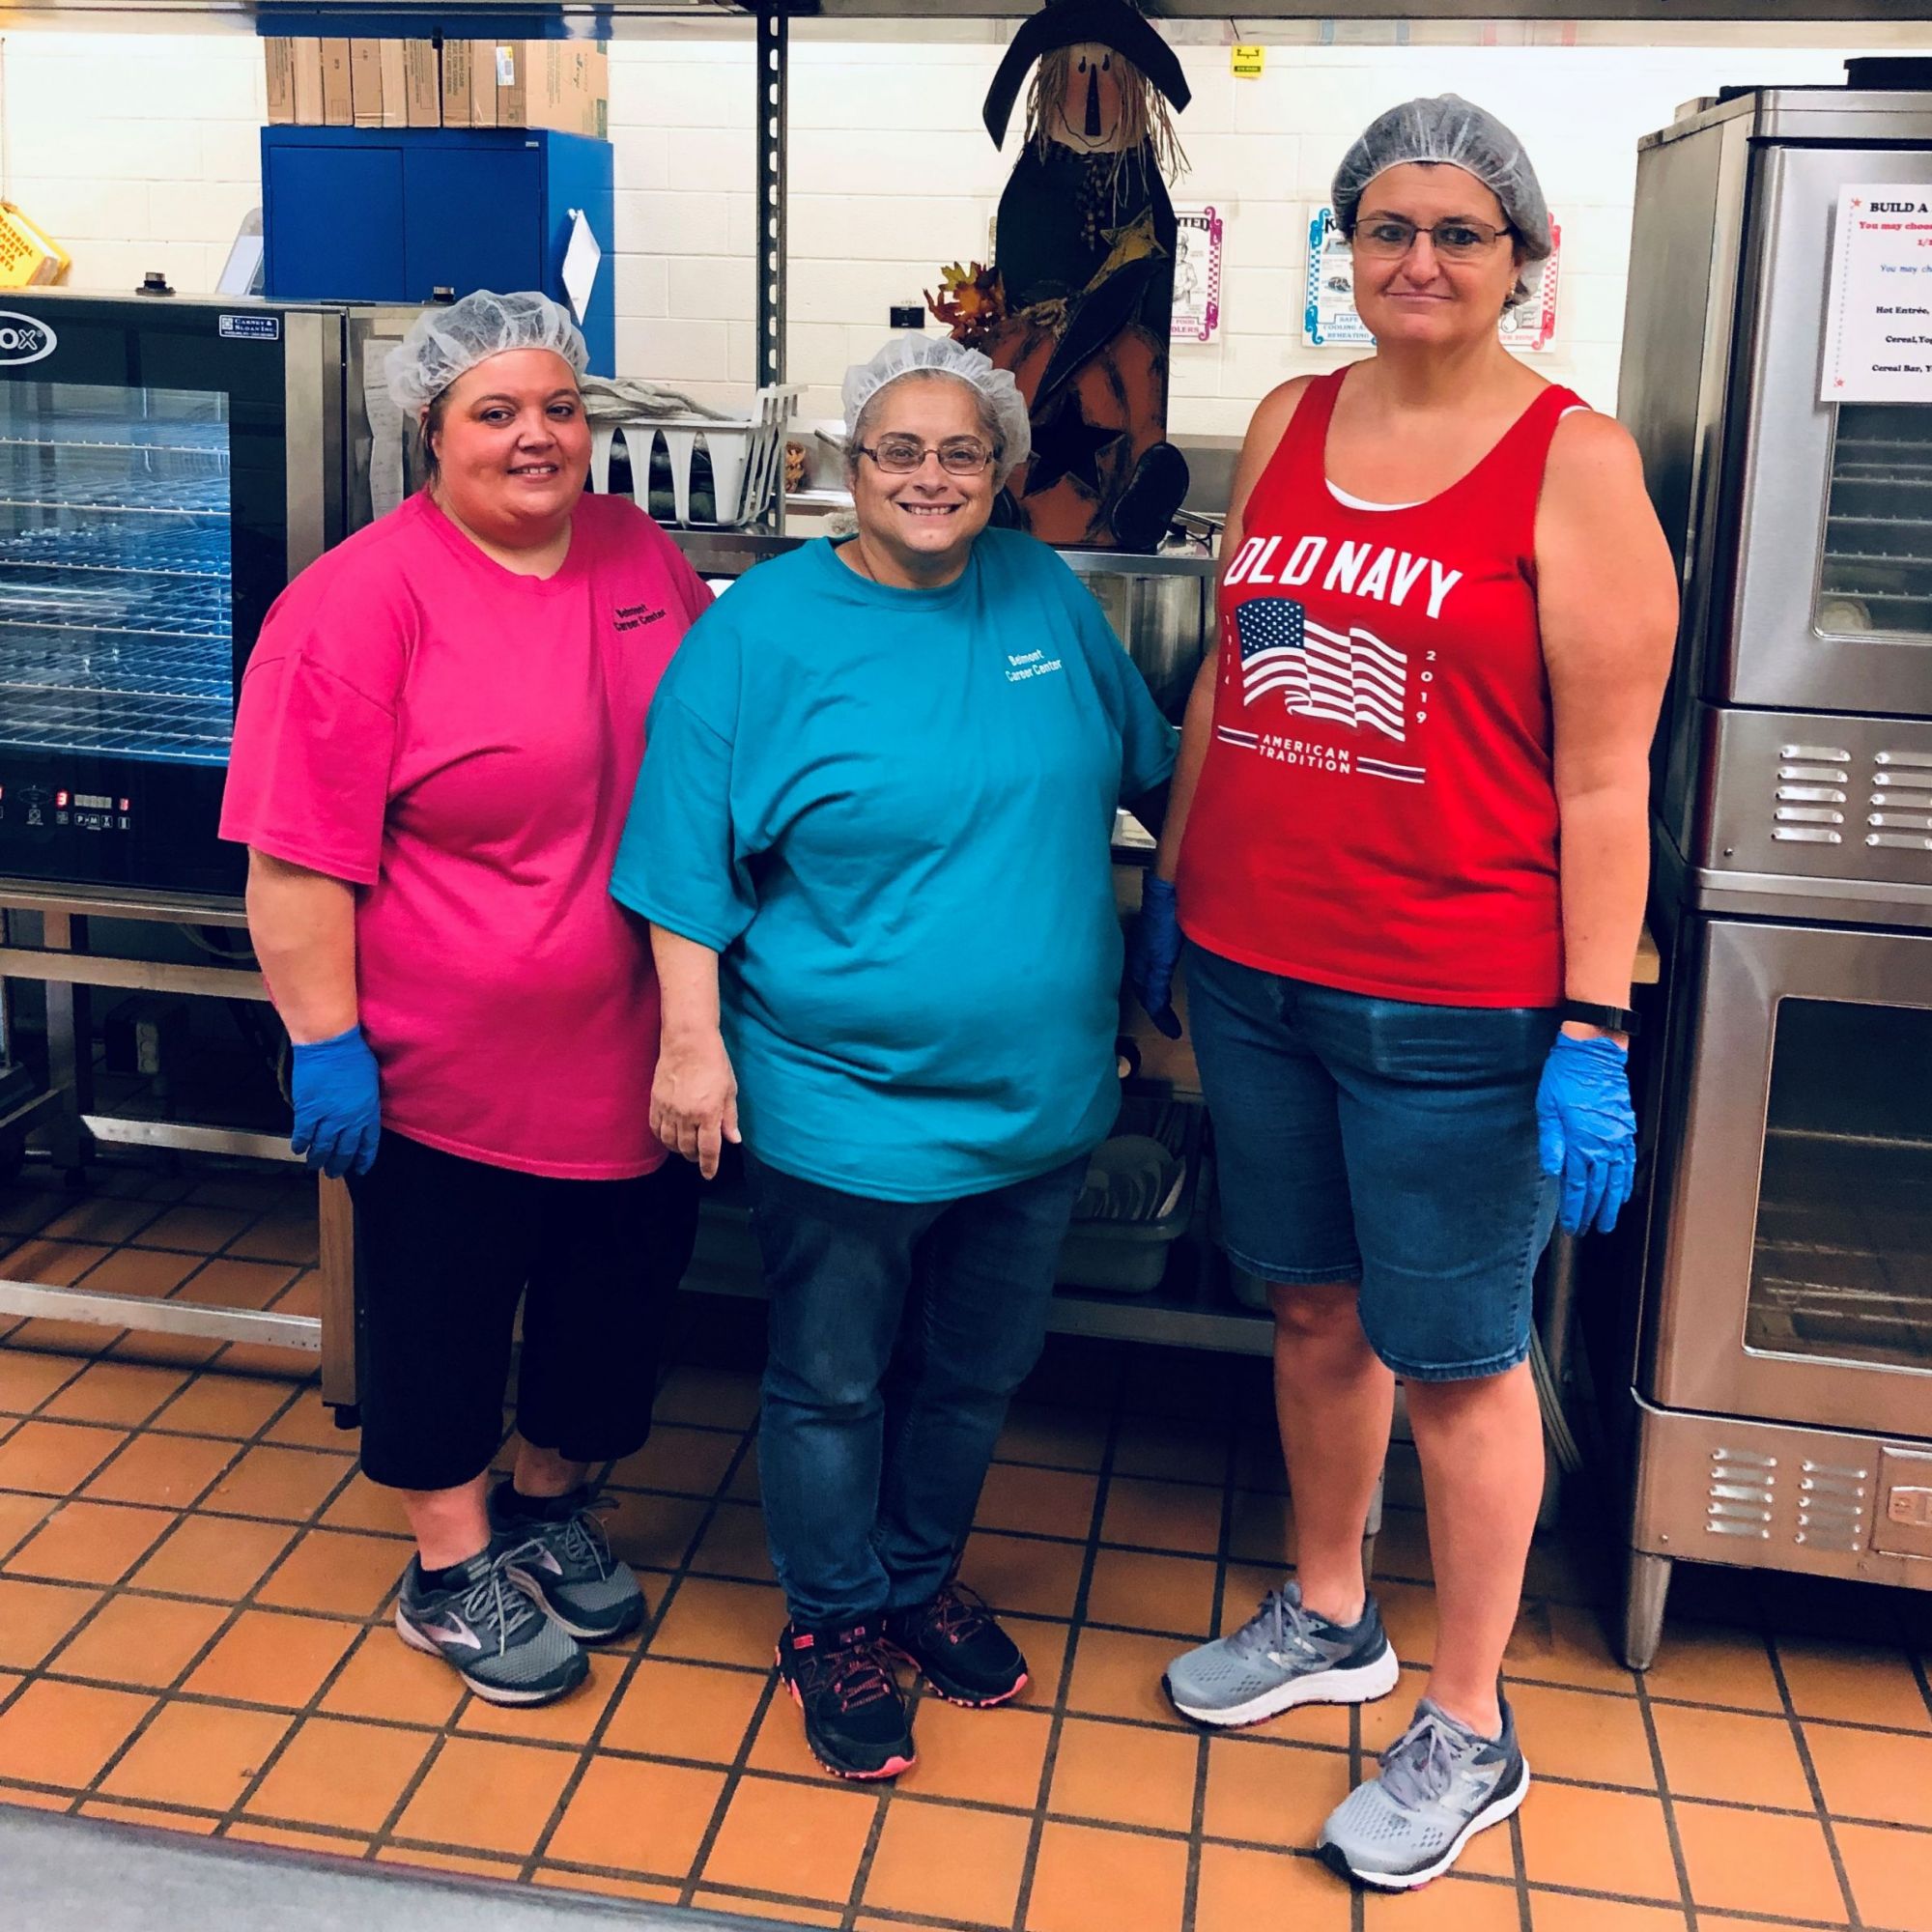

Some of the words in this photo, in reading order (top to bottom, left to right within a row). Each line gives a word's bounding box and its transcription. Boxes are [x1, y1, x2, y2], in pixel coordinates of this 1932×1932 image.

[1870, 202, 1915, 213] BUILD
[1918, 203, 1928, 213] A
[1860, 221, 1879, 230] You
[1881, 264, 1896, 272] You
[1899, 266, 1918, 274] may
[1895, 306, 1930, 315] Entrée,
[1223, 535, 1328, 587] OLD
[1322, 540, 1463, 619] NAVY
[1007, 648, 1045, 667] Belmont
[1005, 668, 1035, 682] Career
[1032, 660, 1062, 675] Center
[1262, 732, 1350, 762] AMERICAN
[1259, 744, 1351, 774] TRADITION
[58, 792, 67, 806] 3
